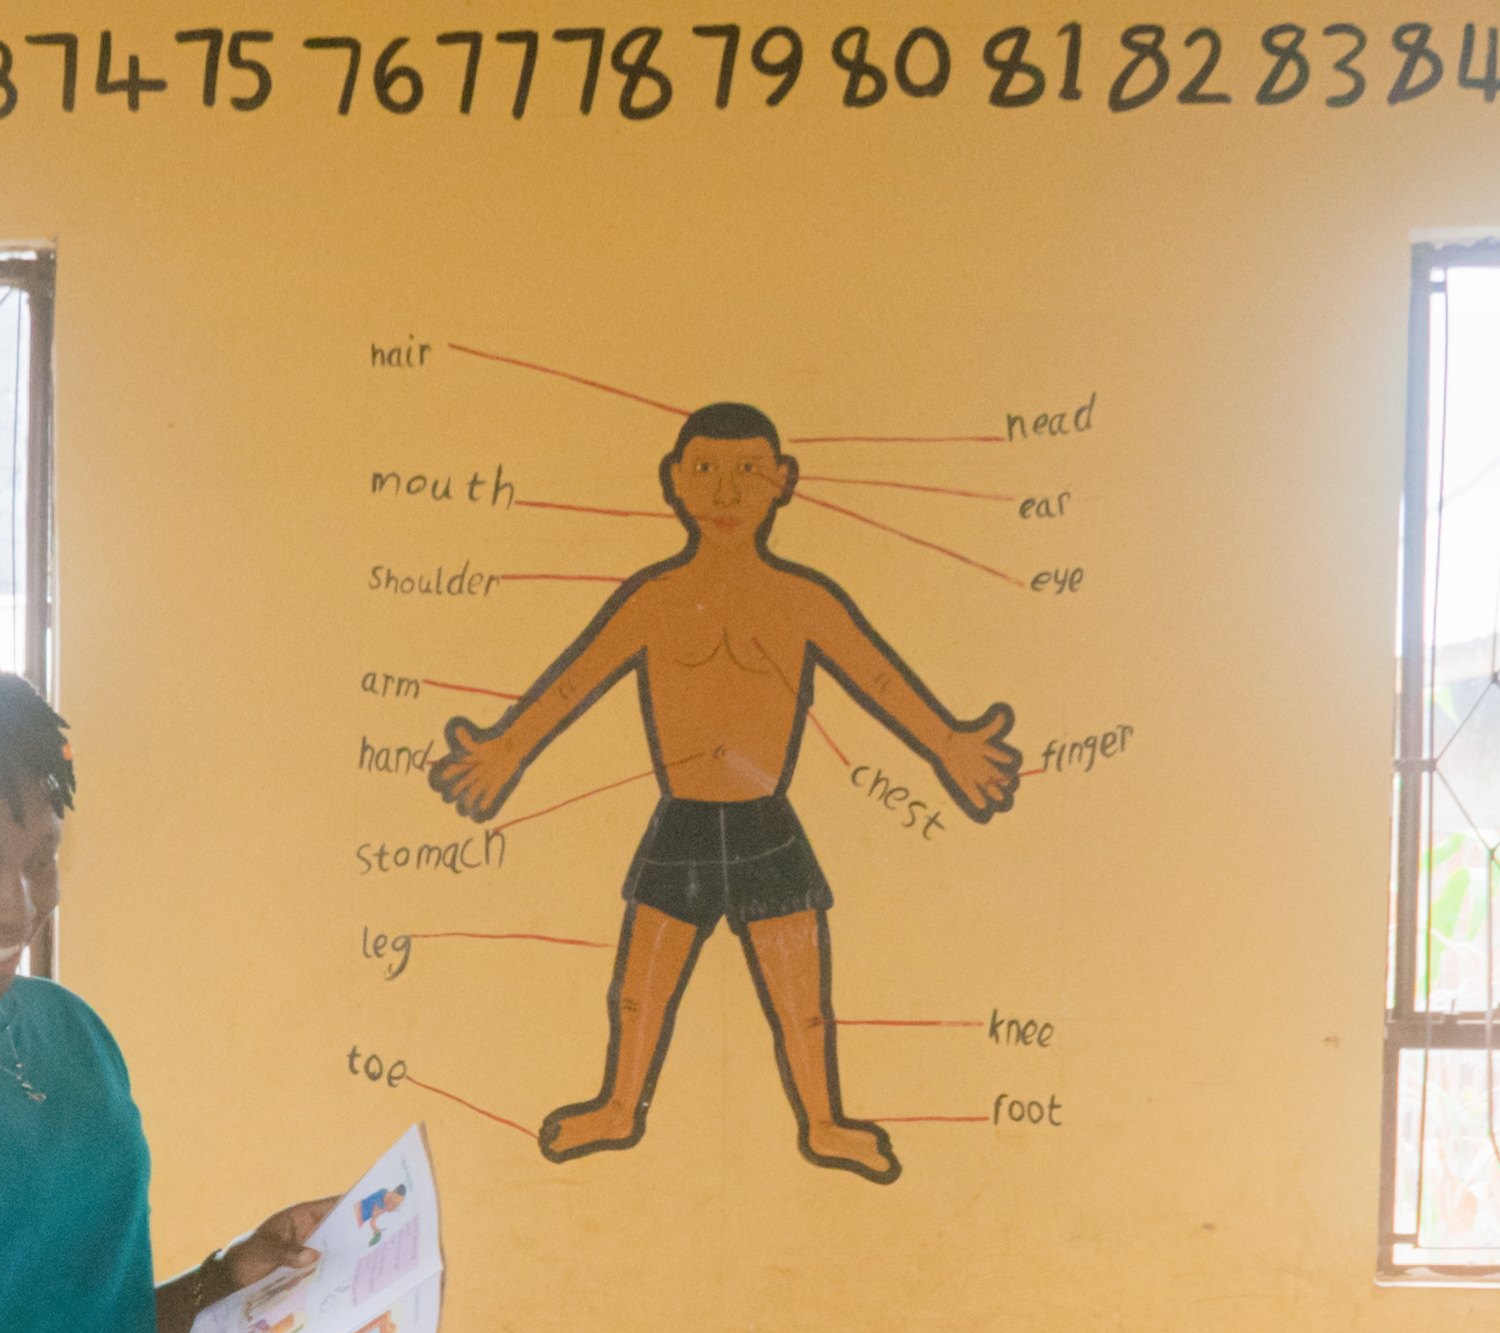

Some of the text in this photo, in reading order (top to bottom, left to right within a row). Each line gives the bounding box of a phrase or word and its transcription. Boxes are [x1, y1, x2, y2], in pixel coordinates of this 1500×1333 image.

[25, 30, 167, 112] 74
[175, 27, 273, 111] 75
[303, 36, 424, 116] 76
[436, 30, 539, 120] 77
[553, 26, 673, 121] 78
[692, 23, 803, 109] 79
[831, 26, 951, 108] 80
[983, 21, 1082, 108] 81
[1108, 24, 1231, 112] 82
[1256, 22, 1366, 107] 83
[370, 462, 516, 511] mouth
[1018, 490, 1072, 520] ear
[1029, 566, 1085, 596] eye
[360, 671, 421, 699] arm
[358, 735, 434, 775] hand
[1040, 723, 1135, 773] finger
[361, 925, 412, 982] leg
[988, 1007, 1055, 1048] knee
[346, 1044, 408, 1088] toe
